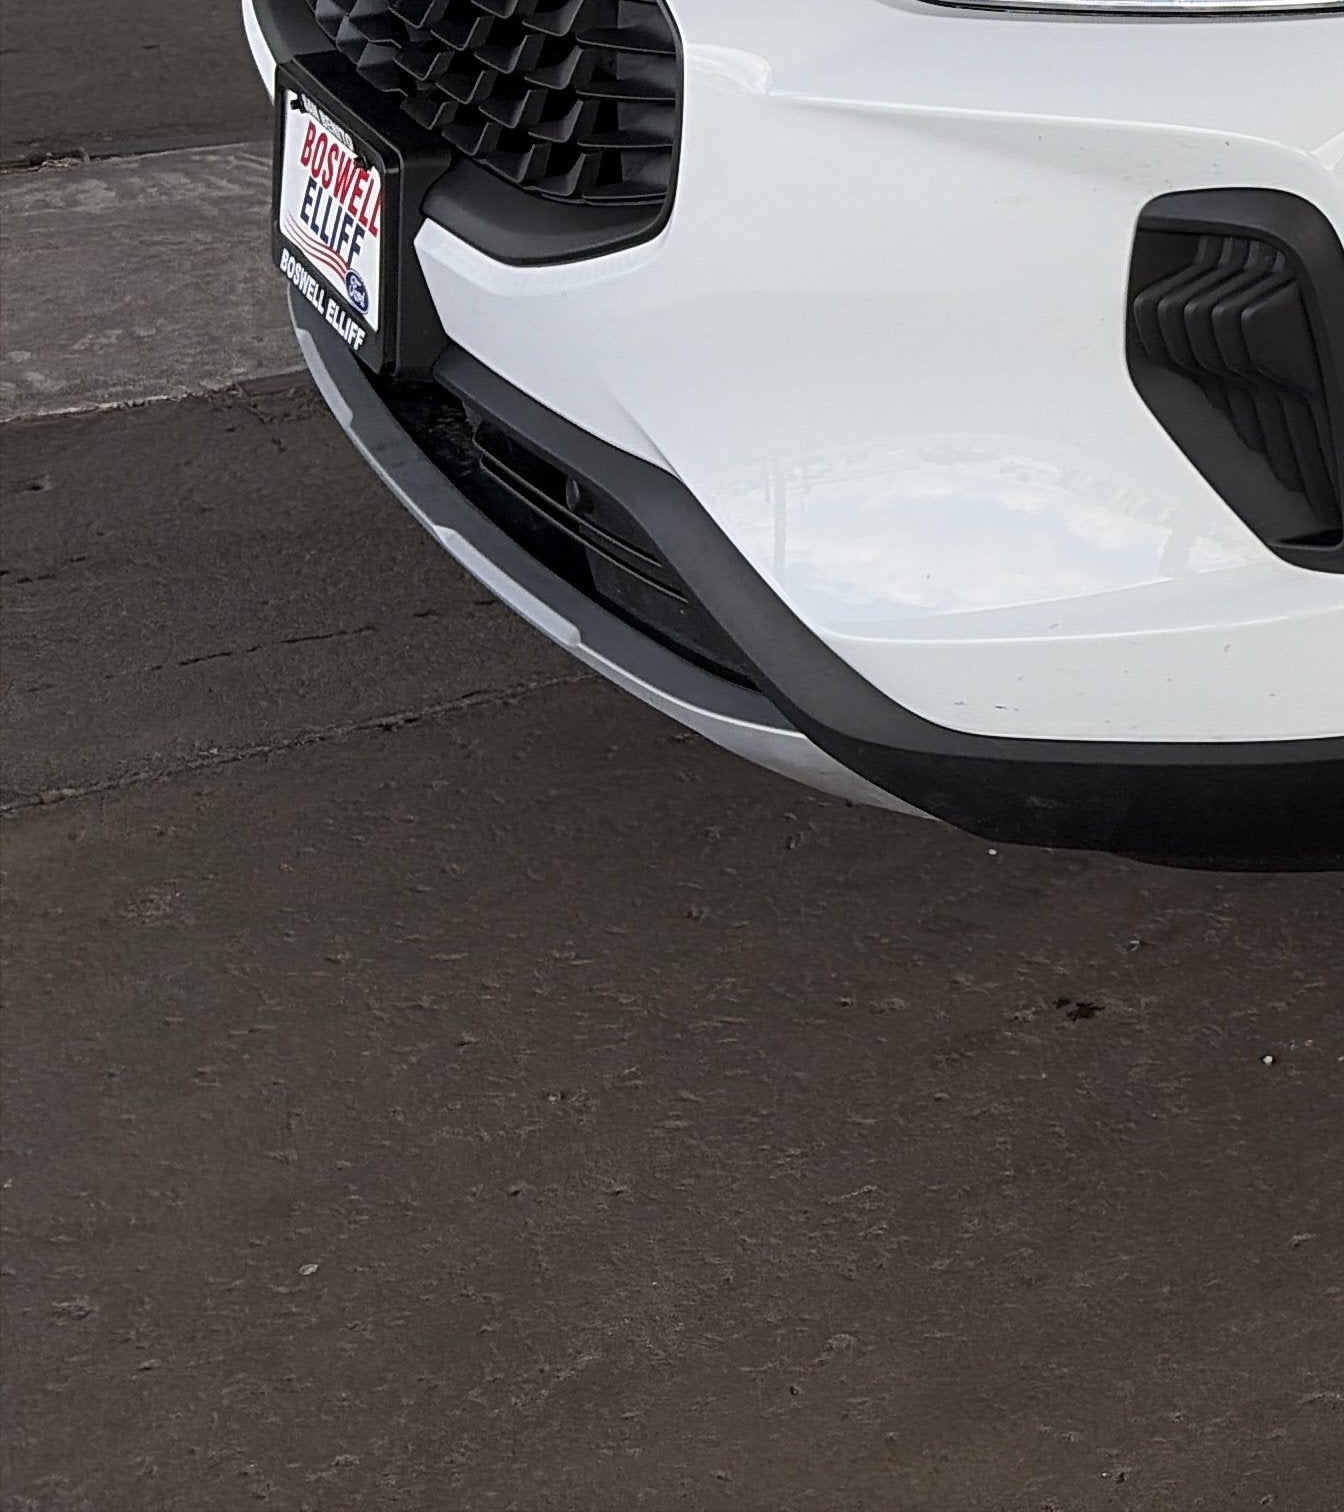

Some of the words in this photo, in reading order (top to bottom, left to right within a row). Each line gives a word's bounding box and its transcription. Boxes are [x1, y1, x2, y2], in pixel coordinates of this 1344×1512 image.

[300, 120, 381, 239] BOSWELL
[299, 175, 365, 269] ELLIFF
[280, 248, 325, 316] BOSWELL
[325, 302, 366, 352] ELLIFF
